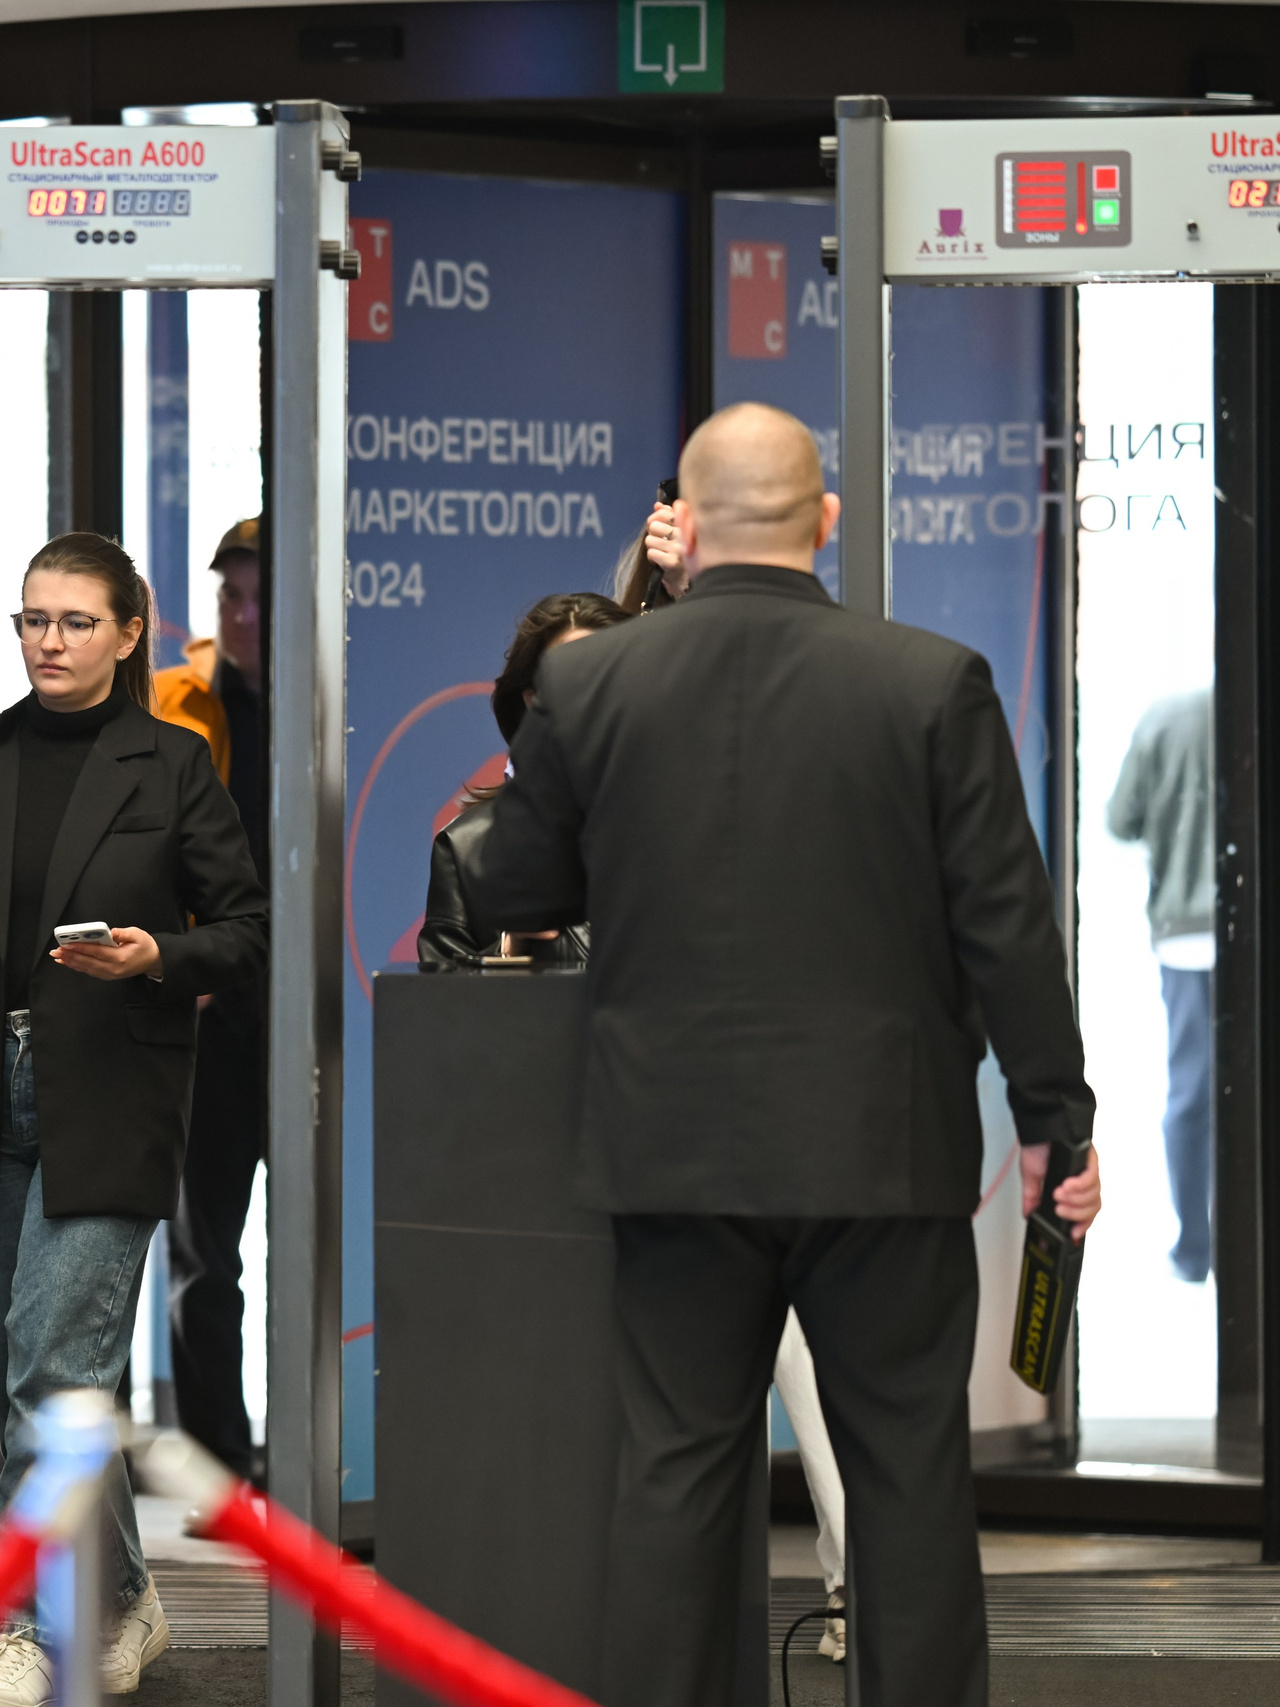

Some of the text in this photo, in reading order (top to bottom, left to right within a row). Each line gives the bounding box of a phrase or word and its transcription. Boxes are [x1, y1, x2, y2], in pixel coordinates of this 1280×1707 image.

[11, 141, 205, 166] UltraScan A600
[8, 172, 218, 183] СТАЦИОНАРНЫЙ МЕТАЛЛОДЕТЕКТОР
[28, 189, 106, 217] 0071
[1229, 180, 1280, 207] 02
[919, 241, 984, 254] Aurix
[406, 260, 490, 311] ADS
[348, 561, 426, 607] 024
